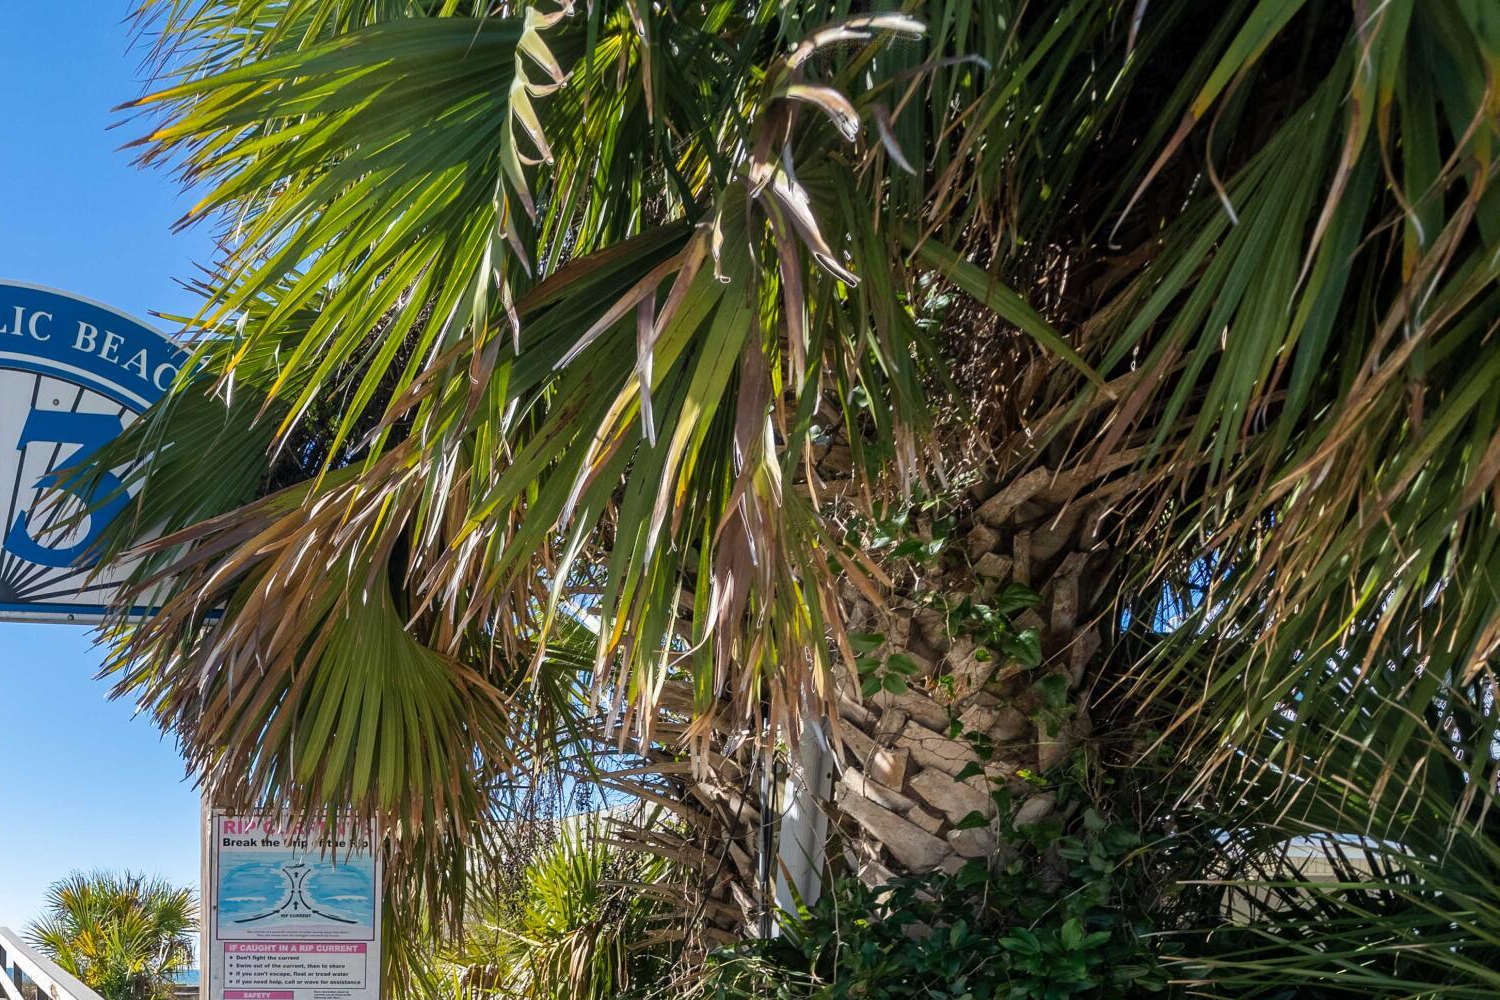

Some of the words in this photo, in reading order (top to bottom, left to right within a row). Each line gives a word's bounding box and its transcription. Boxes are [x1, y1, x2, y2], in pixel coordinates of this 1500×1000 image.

[72, 320, 184, 394] BEAC
[223, 821, 256, 834] RIP
[223, 838, 256, 847] Break
[262, 839, 280, 847] the
